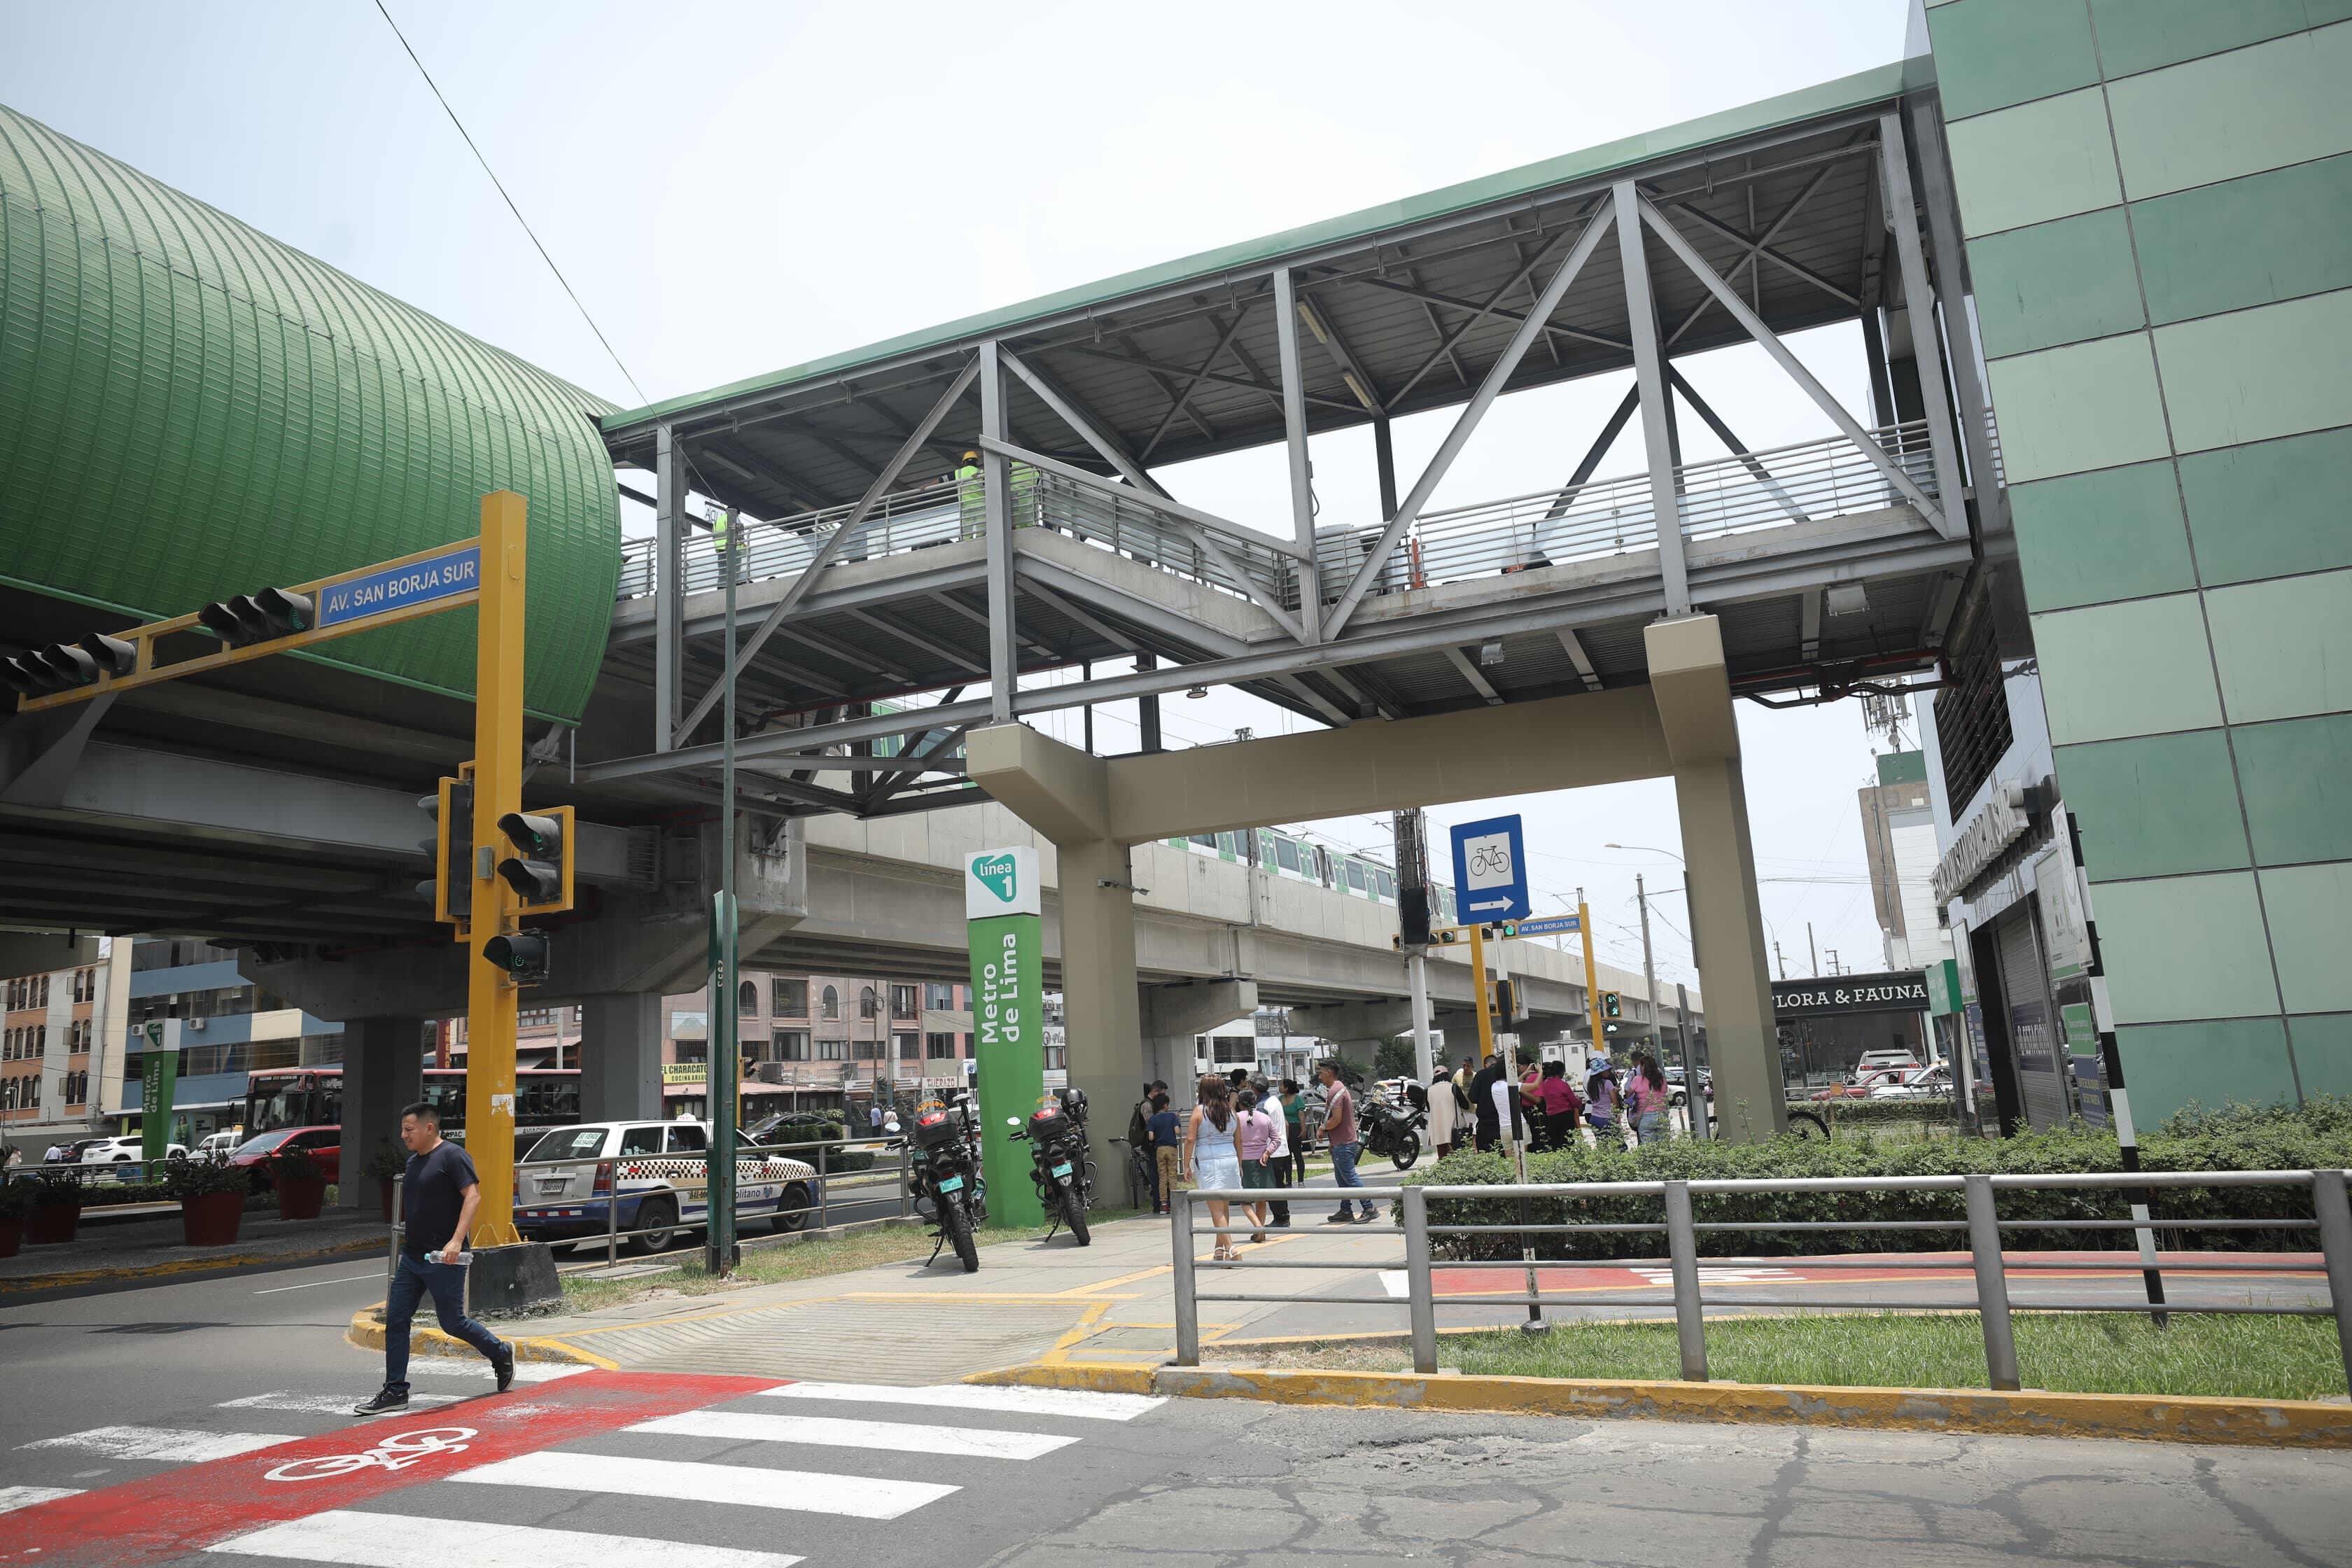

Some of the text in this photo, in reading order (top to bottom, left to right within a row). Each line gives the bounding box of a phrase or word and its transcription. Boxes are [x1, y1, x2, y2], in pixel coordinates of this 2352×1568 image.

[328, 561, 475, 613] AV. SAN BORJA SUR
[1002, 876, 1013, 897] 1
[981, 963, 999, 1043] Metro
[1000, 933, 1020, 1042] de Lima
[1772, 990, 1830, 1008] LORA
[1835, 988, 1850, 1004] &
[1854, 984, 1927, 1002] FAUNA
[143, 1075, 152, 1113] Metro
[150, 1060, 160, 1113] de Lima
[736, 1189, 761, 1198] olitano
